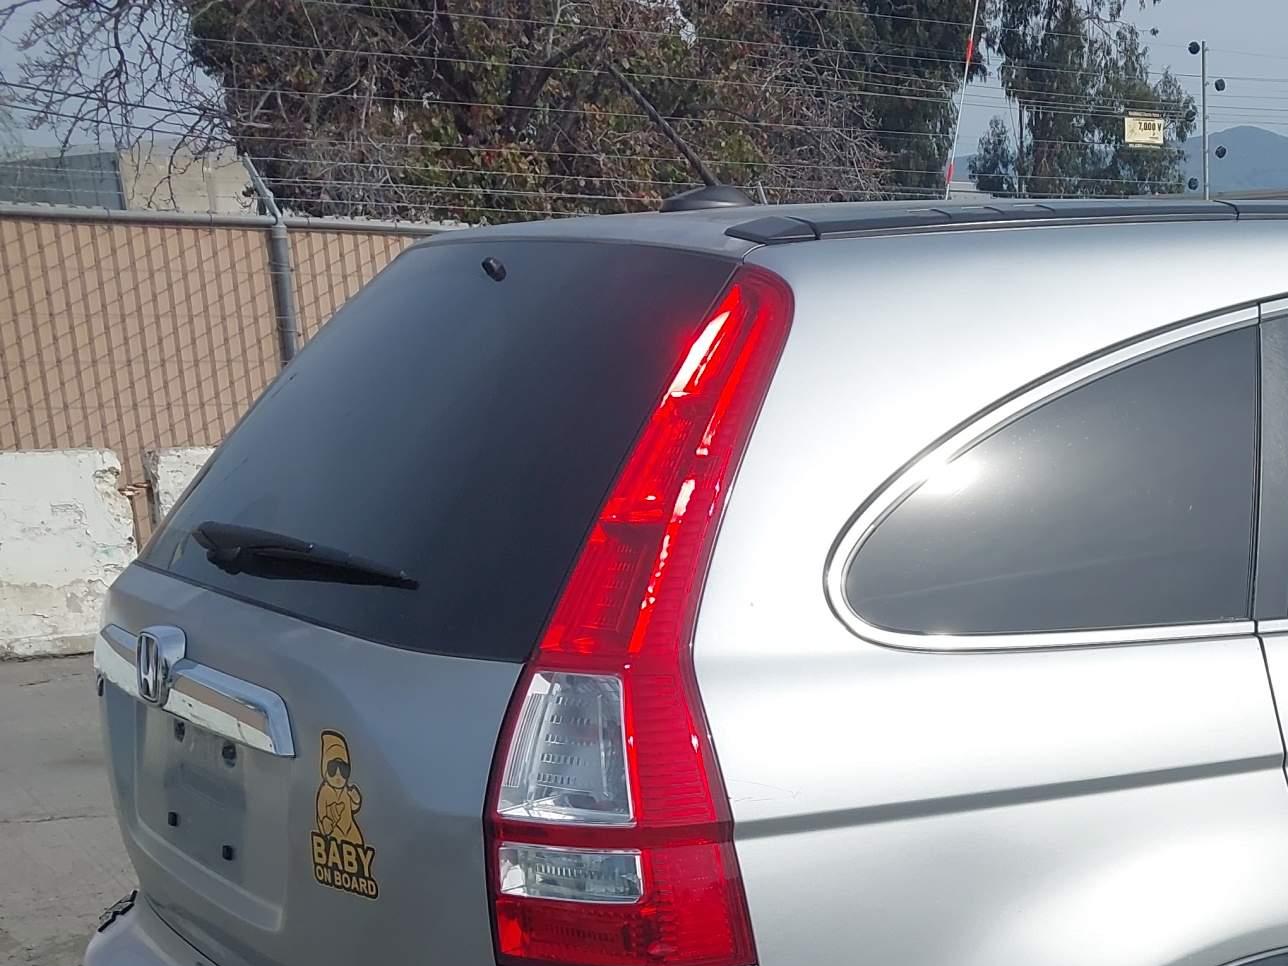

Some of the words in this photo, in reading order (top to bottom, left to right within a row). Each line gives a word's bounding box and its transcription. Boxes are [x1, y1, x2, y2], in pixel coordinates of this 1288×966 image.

[1138, 122, 1156, 132] 7,000
[1158, 123, 1162, 131] V
[313, 836, 373, 877] BABY
[315, 865, 332, 884] ON
[334, 871, 377, 896] BOARD
